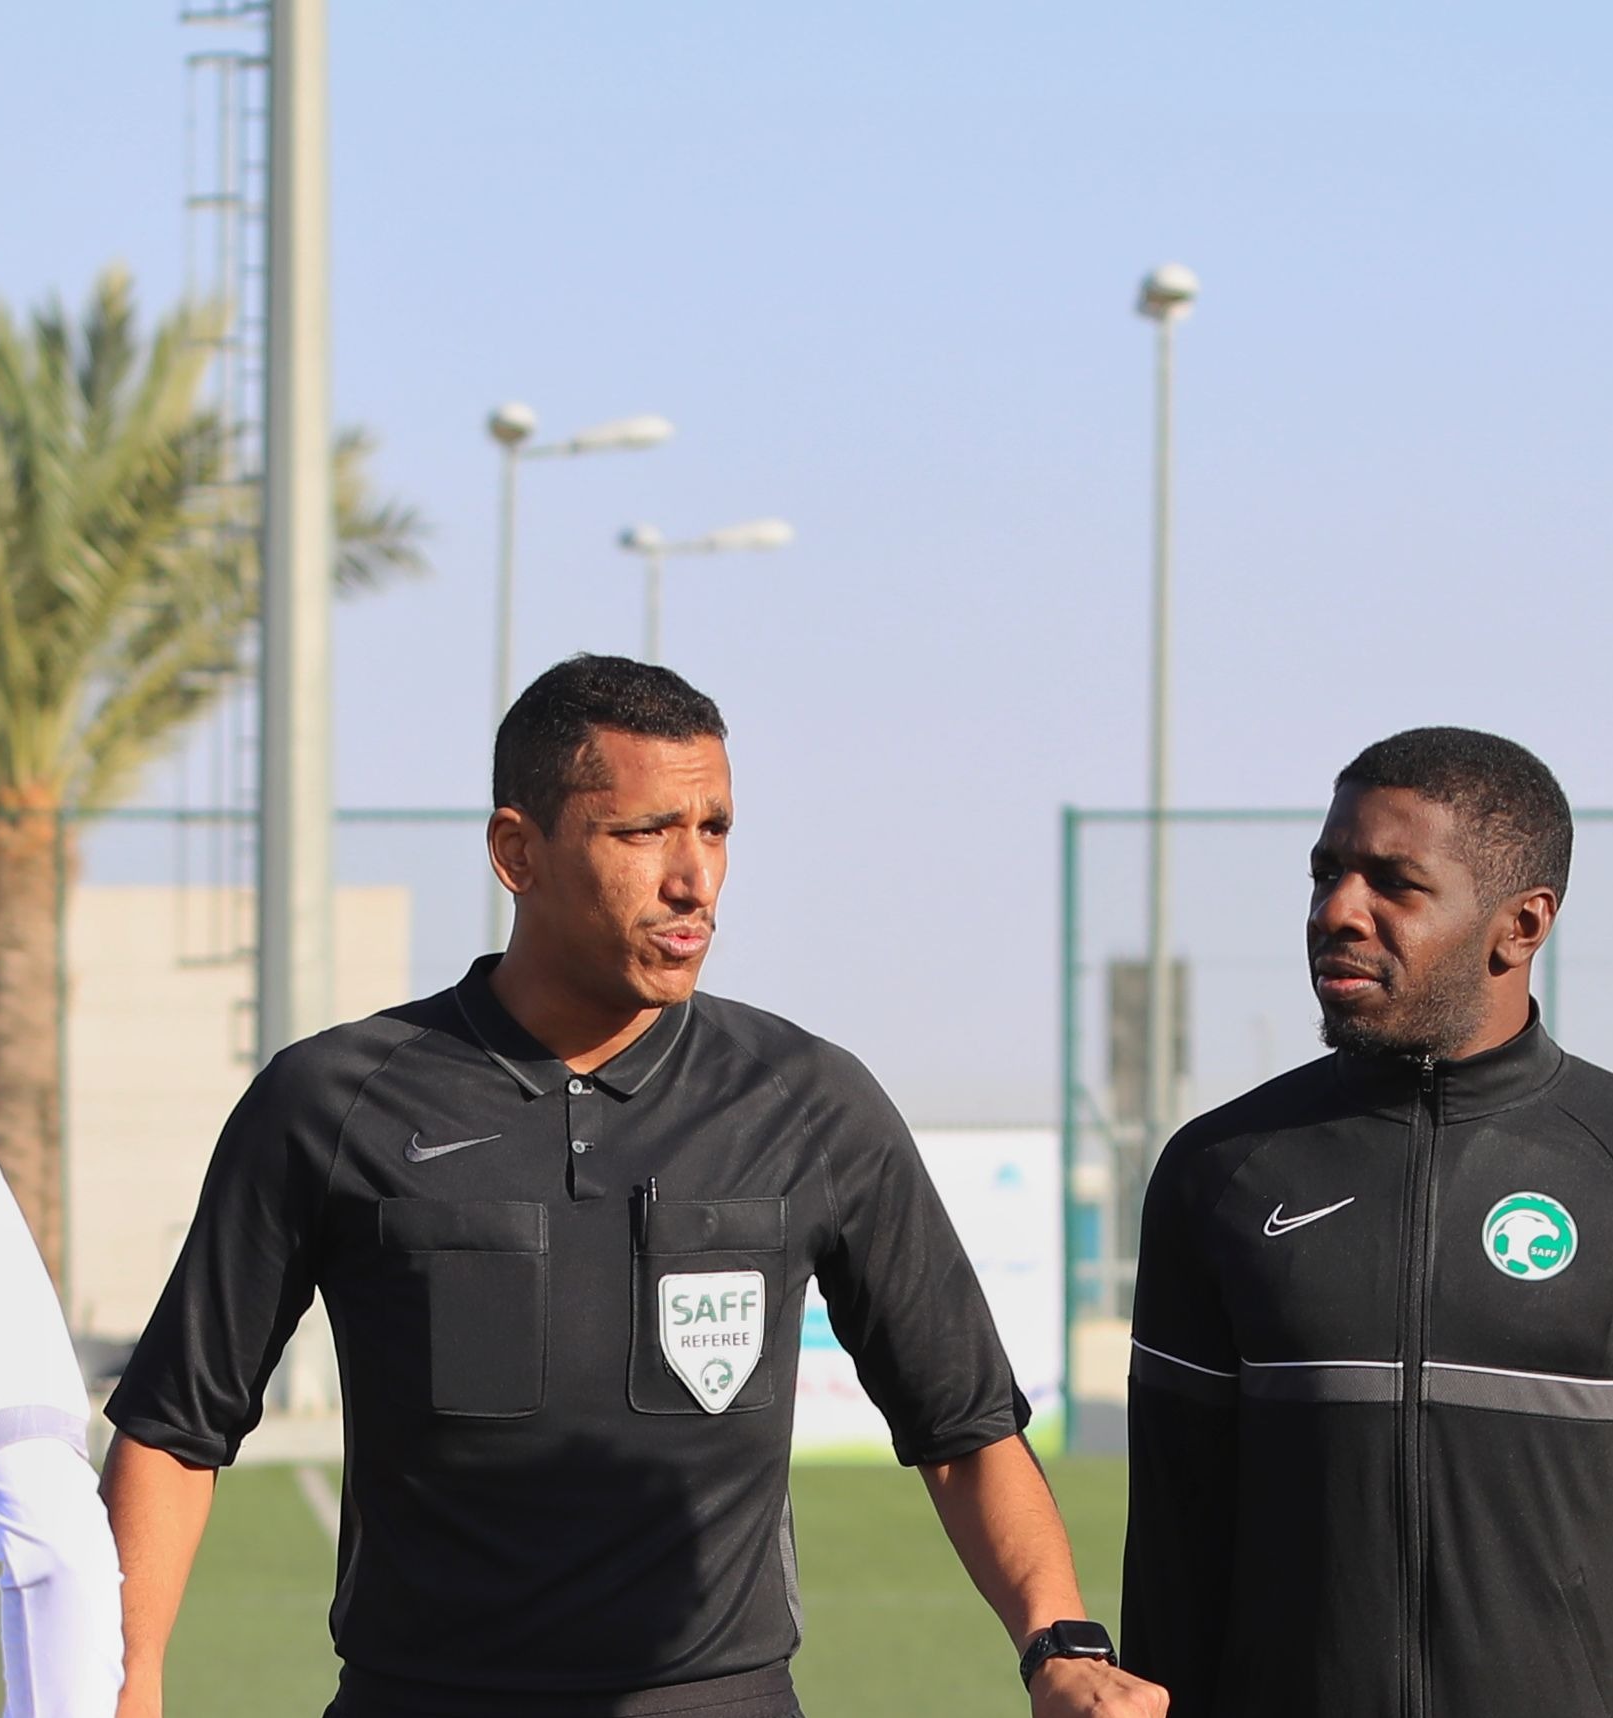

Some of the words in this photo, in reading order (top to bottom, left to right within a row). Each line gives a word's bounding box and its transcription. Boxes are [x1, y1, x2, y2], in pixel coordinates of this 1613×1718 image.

[1530, 1246, 1558, 1258] SAFF
[671, 1290, 757, 1325] SAFF
[681, 1332, 750, 1348] REFEREE
